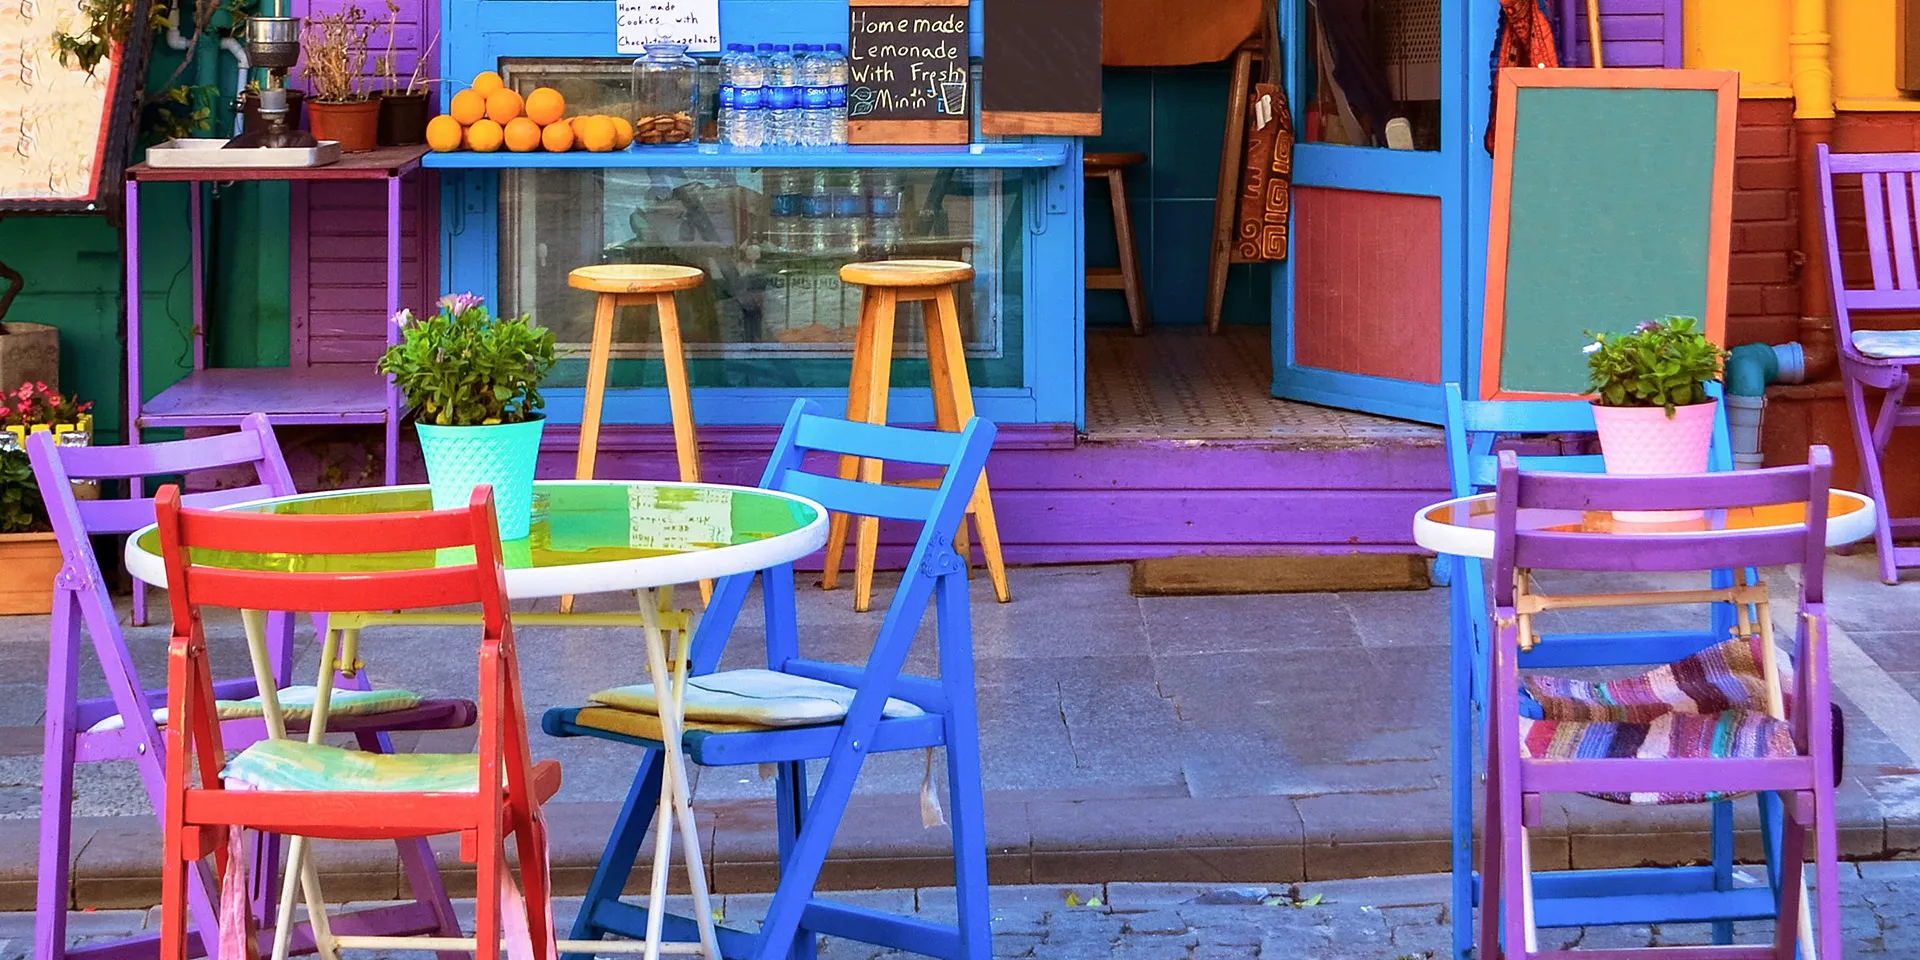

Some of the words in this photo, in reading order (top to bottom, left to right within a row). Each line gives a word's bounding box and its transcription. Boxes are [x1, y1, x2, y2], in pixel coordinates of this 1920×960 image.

[650, 2, 676, 11] made
[617, 14, 660, 27] Cookies
[675, 12, 699, 24] with
[851, 36, 958, 60] Lemonade
[851, 62, 895, 83] With
[911, 61, 960, 86] Fresh
